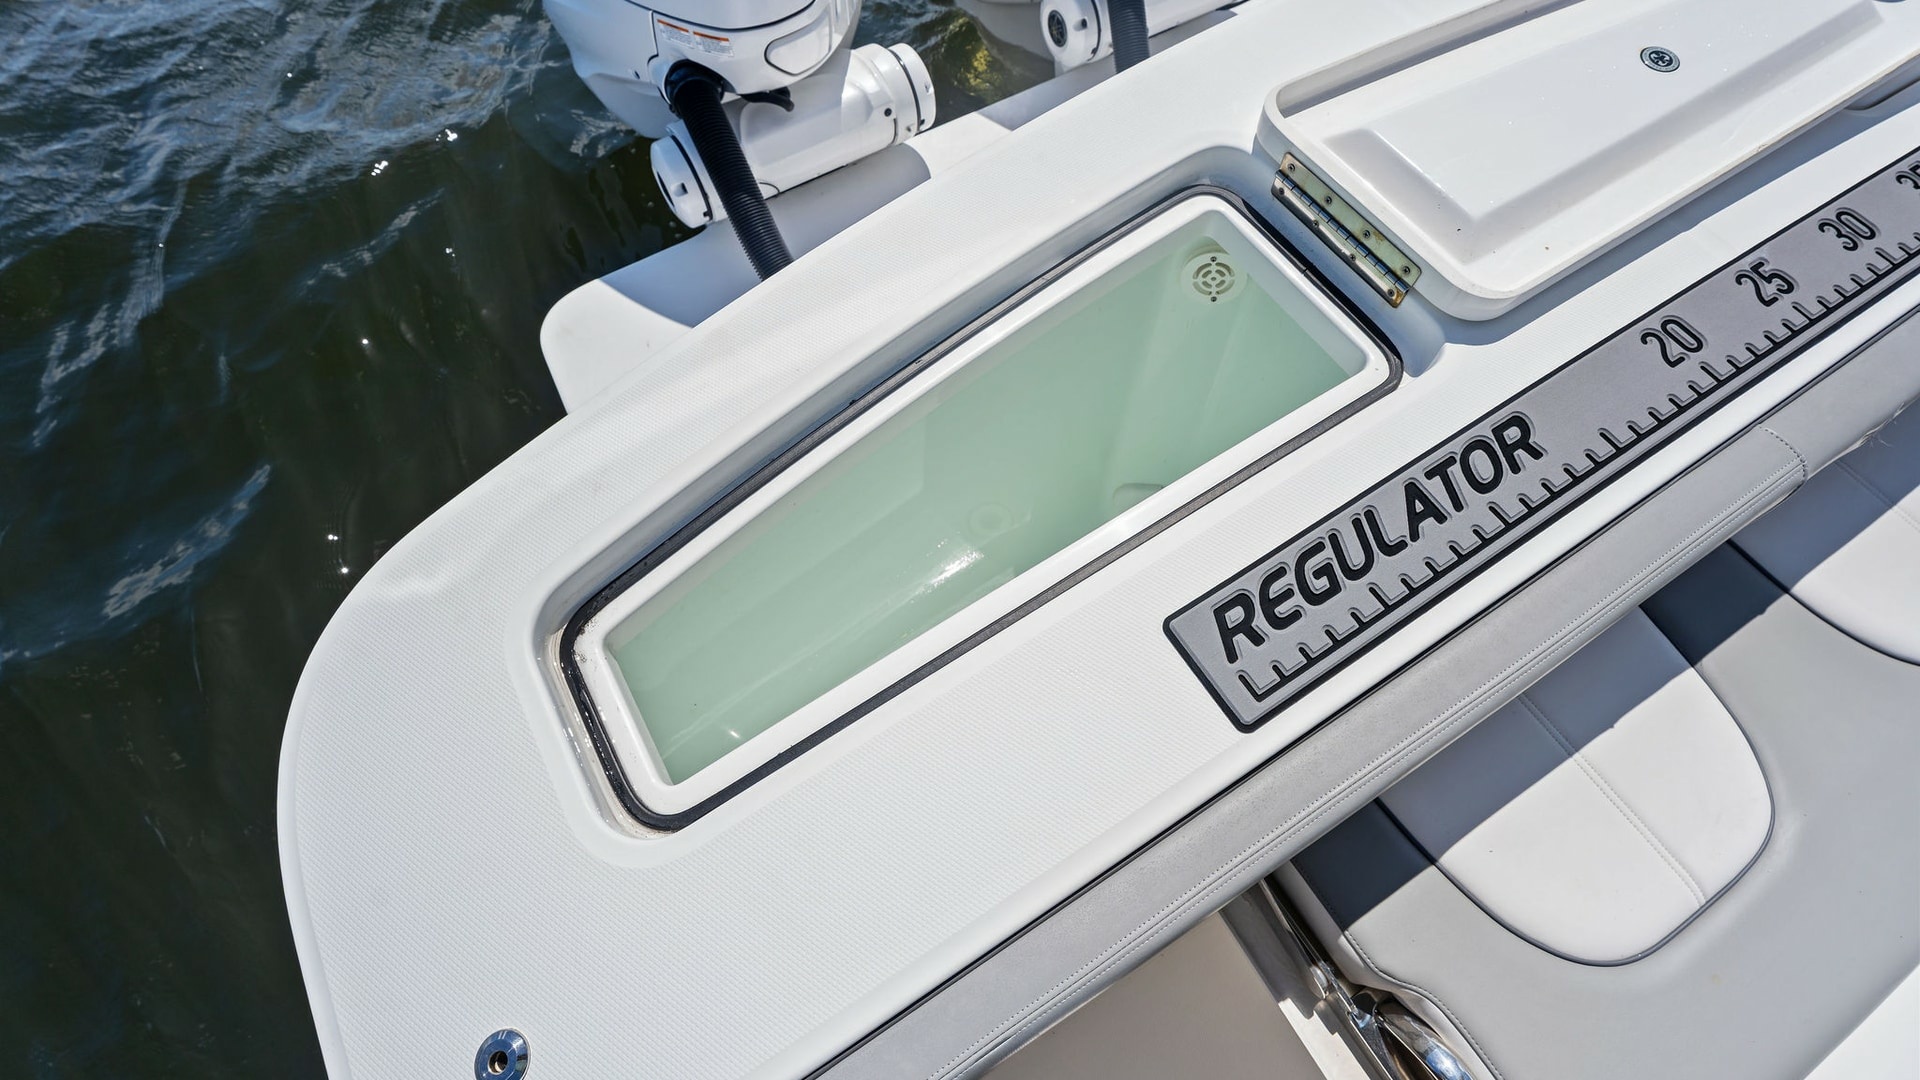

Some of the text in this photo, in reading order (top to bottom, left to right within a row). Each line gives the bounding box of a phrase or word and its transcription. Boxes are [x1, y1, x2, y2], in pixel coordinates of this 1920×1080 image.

[1640, 317, 1705, 369] 20
[1734, 259, 1796, 307] 25
[1818, 209, 1878, 252] 30
[1212, 413, 1545, 665] REGULATOR
